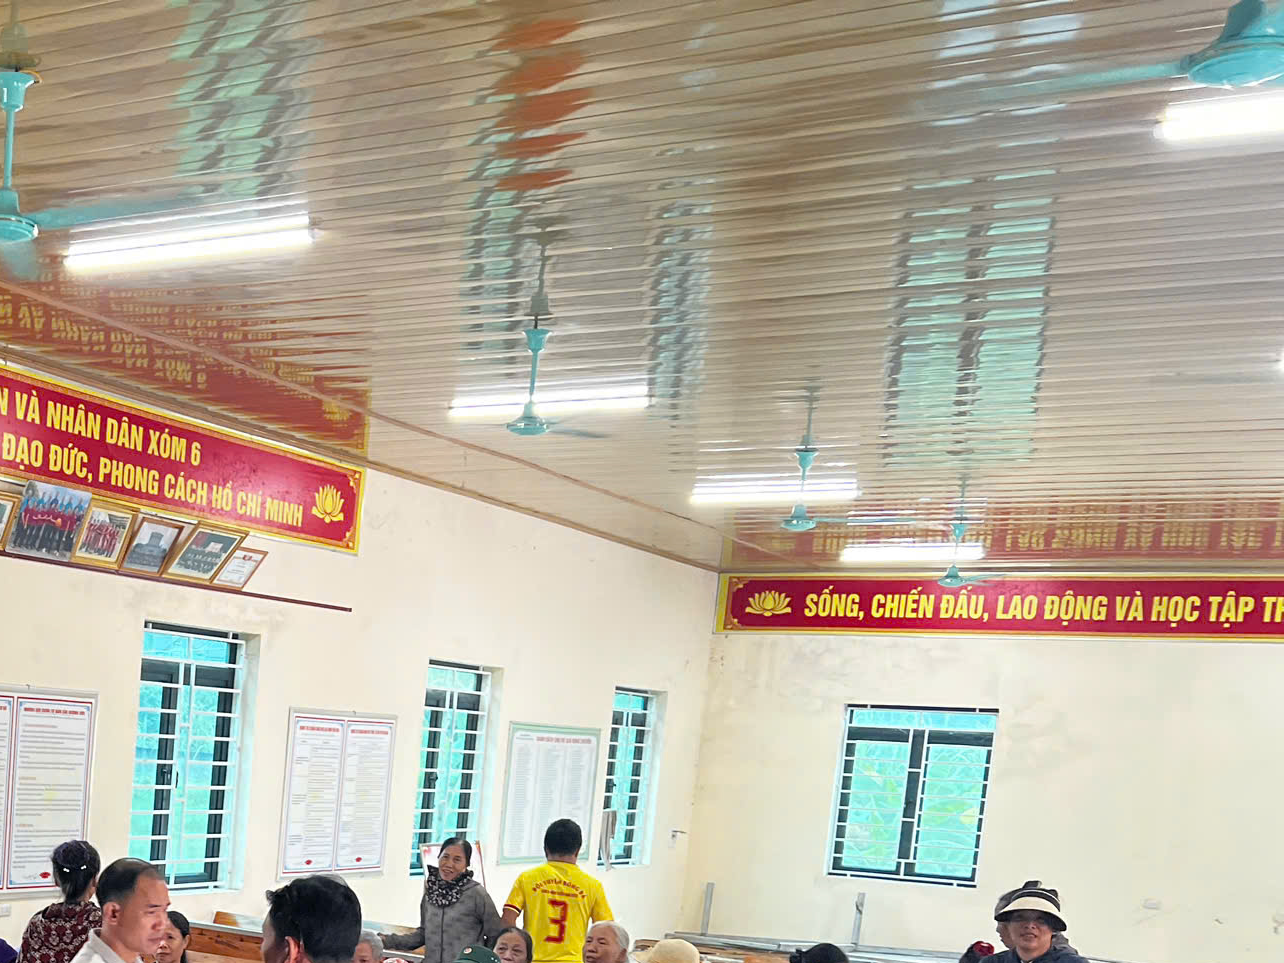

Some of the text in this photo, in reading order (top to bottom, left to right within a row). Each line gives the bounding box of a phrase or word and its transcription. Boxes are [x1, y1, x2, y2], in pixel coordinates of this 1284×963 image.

[15, 389, 40, 425] VÀ
[47, 400, 101, 441] NHÂN
[106, 416, 144, 452] DÂN
[148, 428, 187, 463] XÓM
[191, 442, 202, 466] 6
[2, 432, 44, 471] ĐẠO
[49, 443, 93, 483] ĐỨC,
[99, 456, 160, 496] PHONG
[164, 472, 208, 506] CÁCH
[212, 481, 232, 511] HỒ
[237, 491, 261, 518] CHÍ
[266, 497, 303, 527] MINH
[804, 585, 864, 621] SỐNG,
[871, 587, 934, 619] CHIẾN
[940, 585, 989, 622] ĐẤU,
[996, 595, 1038, 620] LAO
[1044, 590, 1108, 626] ĐỘNG
[1115, 591, 1144, 622] VÀ
[1151, 596, 1201, 628] HỌC
[1209, 590, 1255, 628] TẬP
[544, 899, 569, 944] 3
